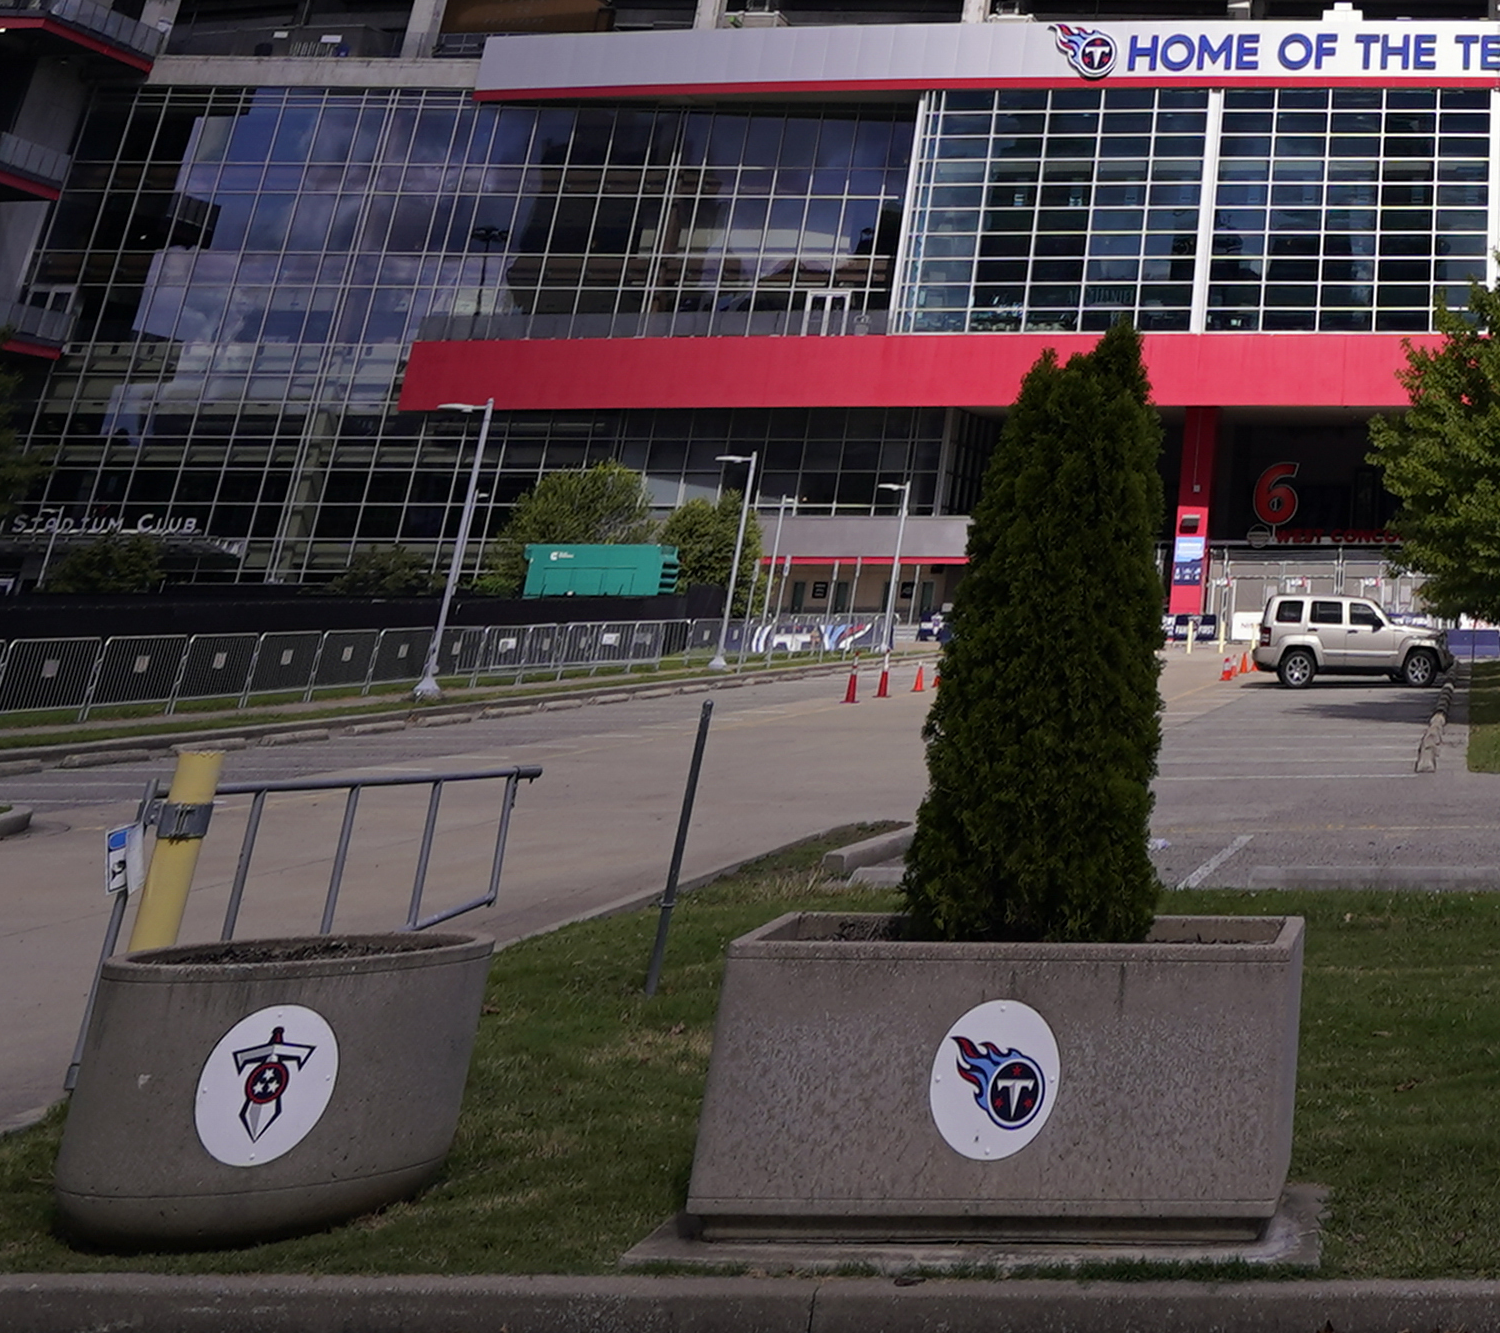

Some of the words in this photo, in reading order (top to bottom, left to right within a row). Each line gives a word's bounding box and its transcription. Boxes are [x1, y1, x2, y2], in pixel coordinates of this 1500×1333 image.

[1126, 33, 1260, 72] HOME
[1278, 33, 1338, 71] OF
[1355, 34, 1437, 70] THE
[1252, 462, 1300, 526] 6
[11, 513, 125, 534] STADIUM
[136, 513, 198, 534] CLUB
[1275, 528, 1324, 544] WEST
